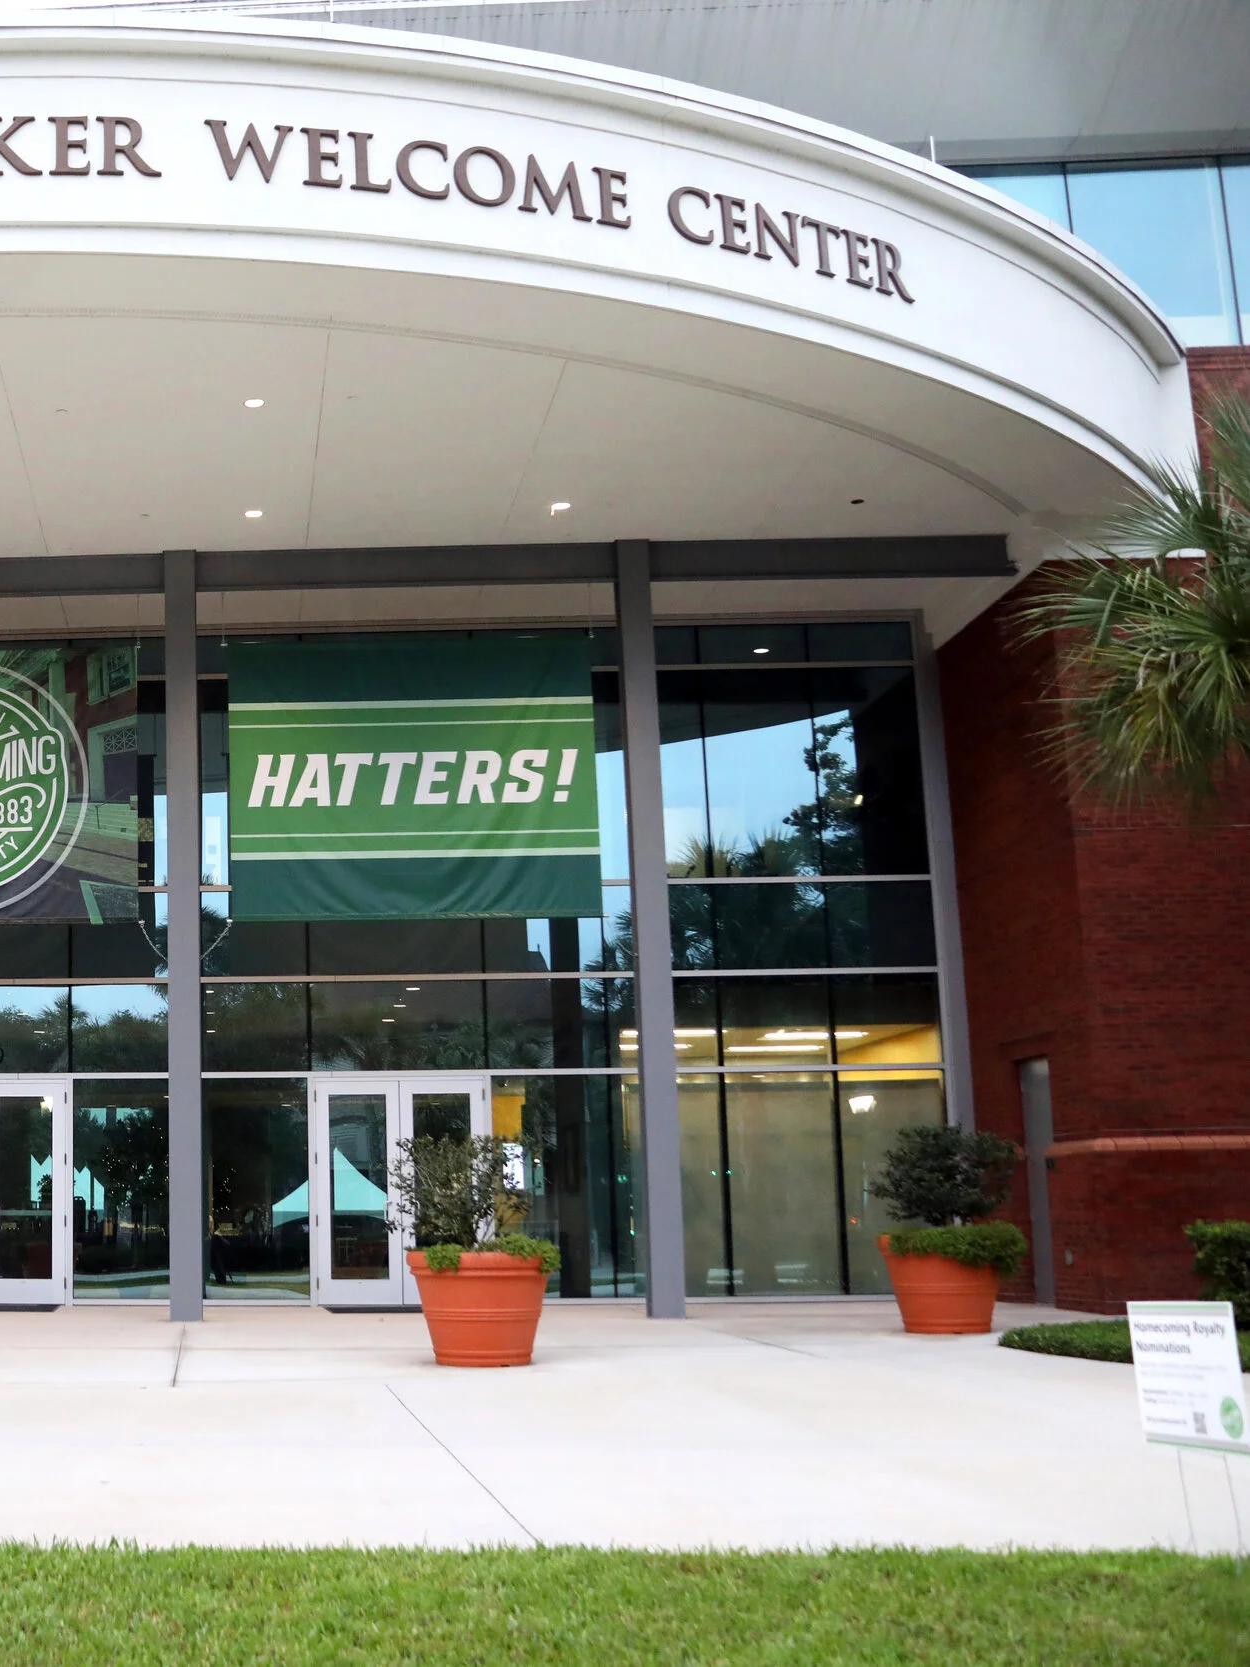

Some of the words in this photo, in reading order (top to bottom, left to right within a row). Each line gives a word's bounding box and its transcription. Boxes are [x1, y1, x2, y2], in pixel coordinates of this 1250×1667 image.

[203, 119, 632, 229] WELCOME
[667, 185, 916, 304] CENTER
[247, 748, 579, 808] HATTERS!
